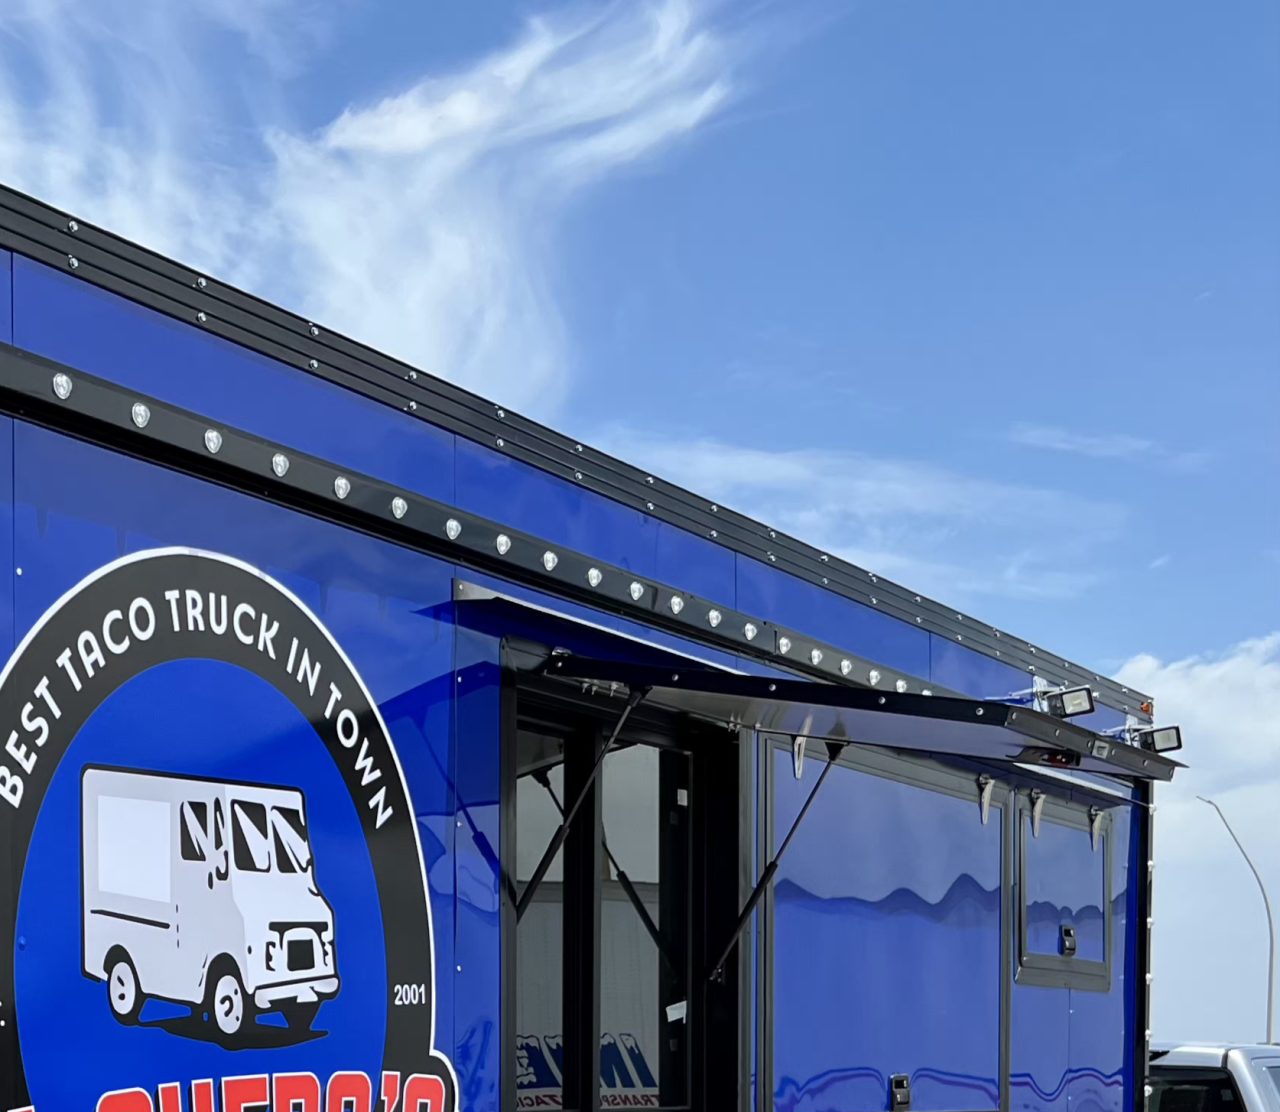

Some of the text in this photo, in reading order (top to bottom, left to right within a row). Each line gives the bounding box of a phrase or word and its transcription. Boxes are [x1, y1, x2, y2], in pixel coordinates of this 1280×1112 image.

[56, 597, 157, 692] TACO
[164, 589, 280, 660] TRUCK
[285, 637, 321, 696] IN
[324, 682, 394, 829] TOWN
[393, 983, 426, 1007] 2001
